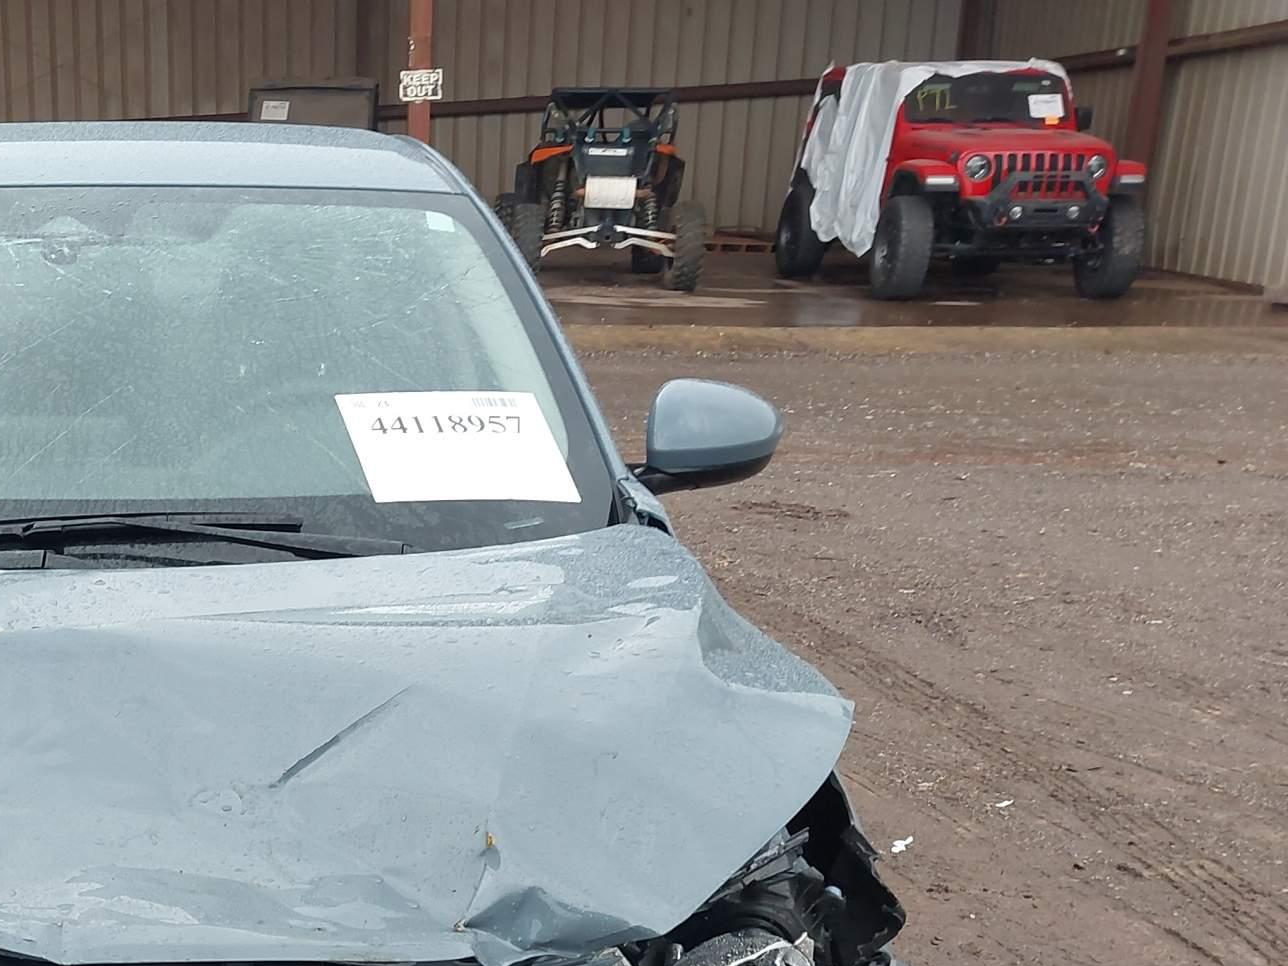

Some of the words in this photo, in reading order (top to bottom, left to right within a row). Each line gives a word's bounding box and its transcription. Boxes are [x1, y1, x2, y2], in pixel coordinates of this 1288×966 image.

[403, 73, 439, 86] KEEP
[406, 85, 436, 97] OUT
[371, 415, 521, 434] 44118957
